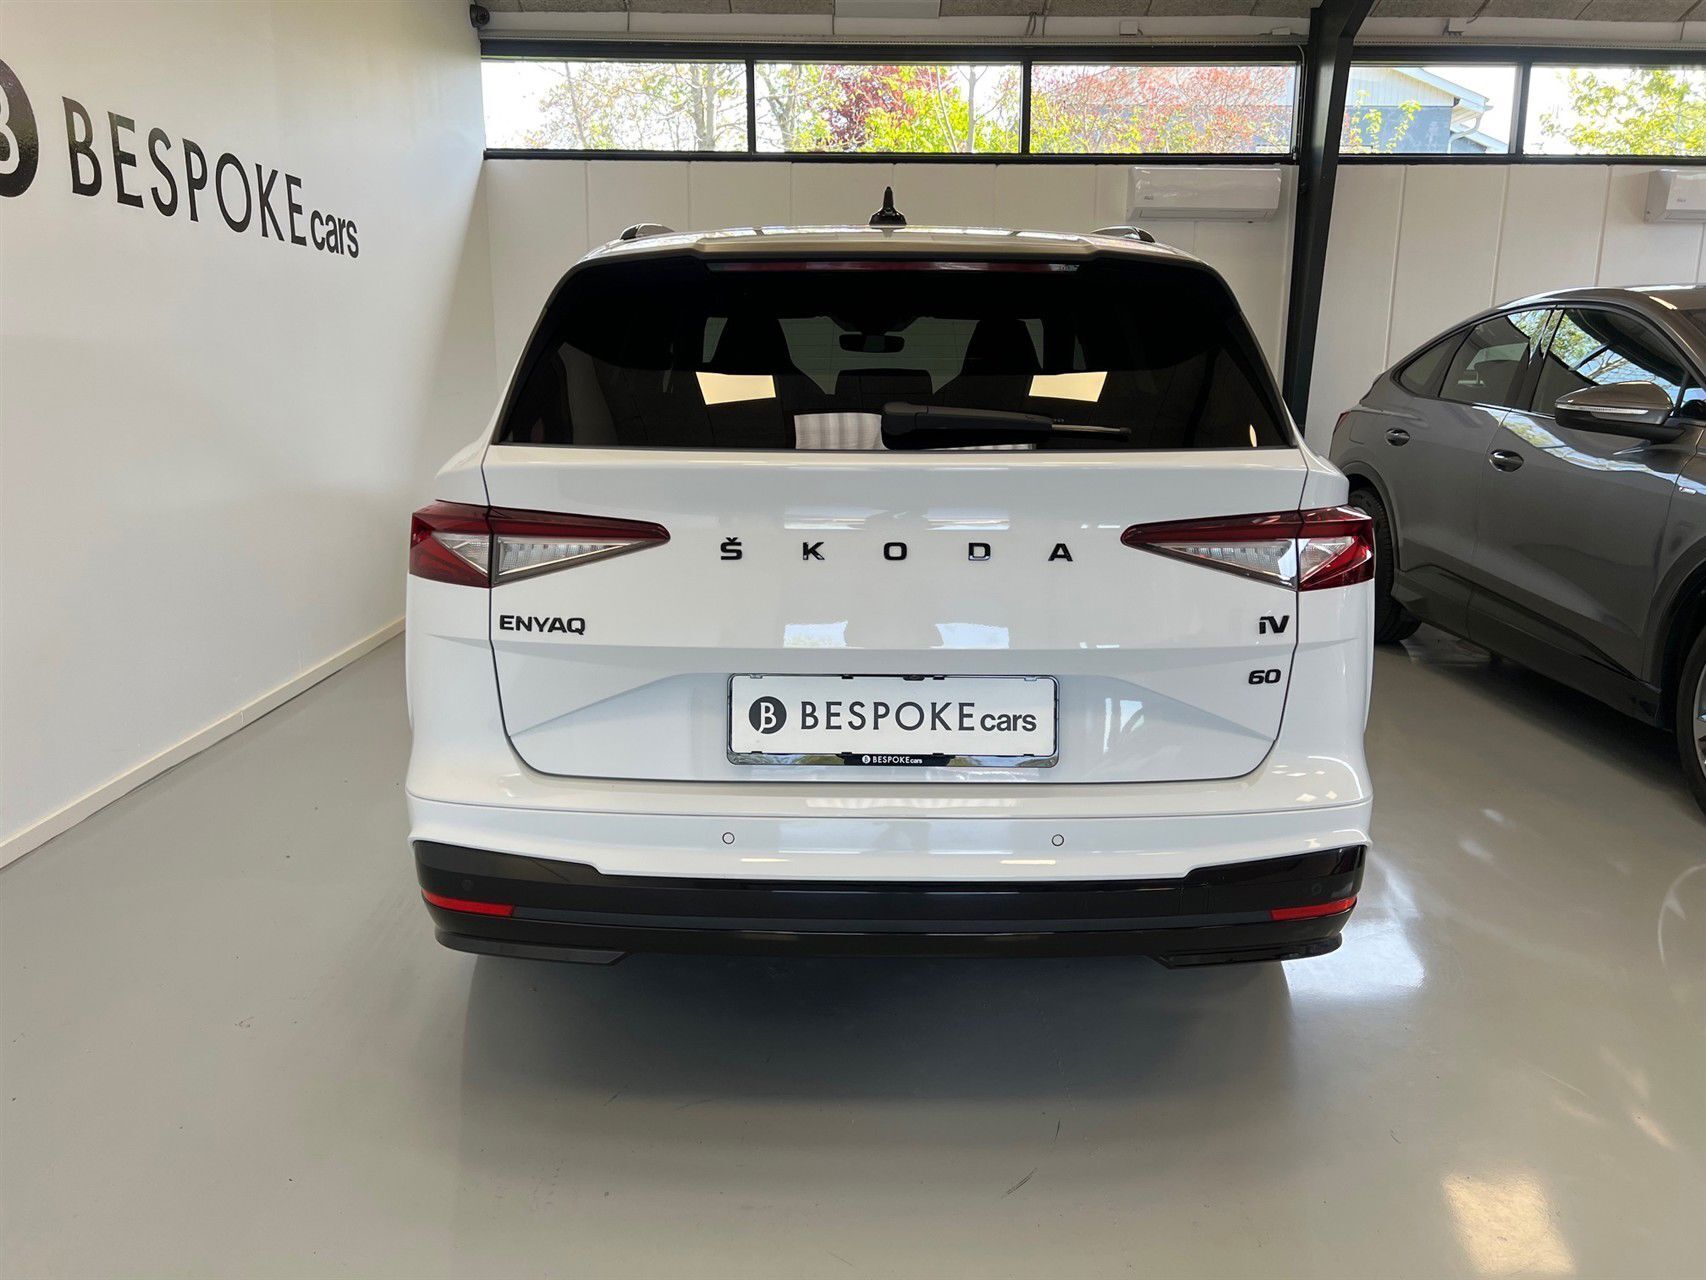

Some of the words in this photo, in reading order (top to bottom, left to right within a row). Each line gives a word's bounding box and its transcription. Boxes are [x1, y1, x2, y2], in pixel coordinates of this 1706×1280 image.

[62, 96, 307, 247] BESPOKE
[310, 209, 359, 259] cars
[720, 536, 1074, 562] ŠKODA
[499, 614, 586, 636] ENYAQ
[1248, 668, 1282, 685] 60
[800, 701, 976, 731] BESPOKE
[980, 712, 1037, 732] cars
[872, 755, 910, 764] BESPOKE
